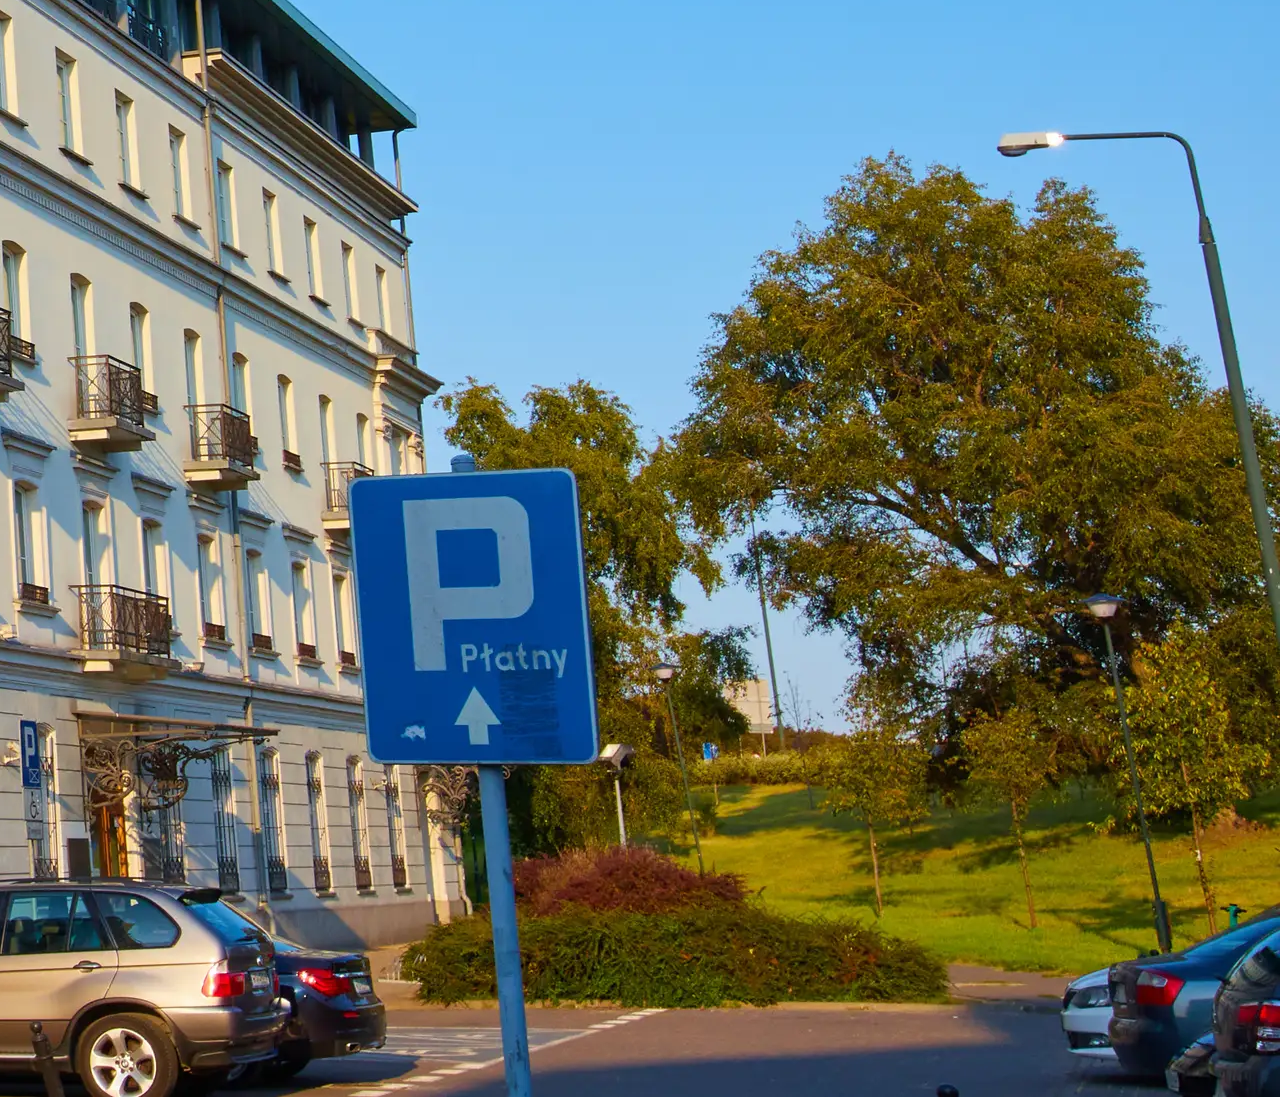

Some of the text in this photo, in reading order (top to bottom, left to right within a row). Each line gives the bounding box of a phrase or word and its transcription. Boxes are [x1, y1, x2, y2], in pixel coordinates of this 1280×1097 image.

[402, 496, 534, 671] P
[460, 642, 568, 678] Płatny
[24, 726, 35, 767] P
